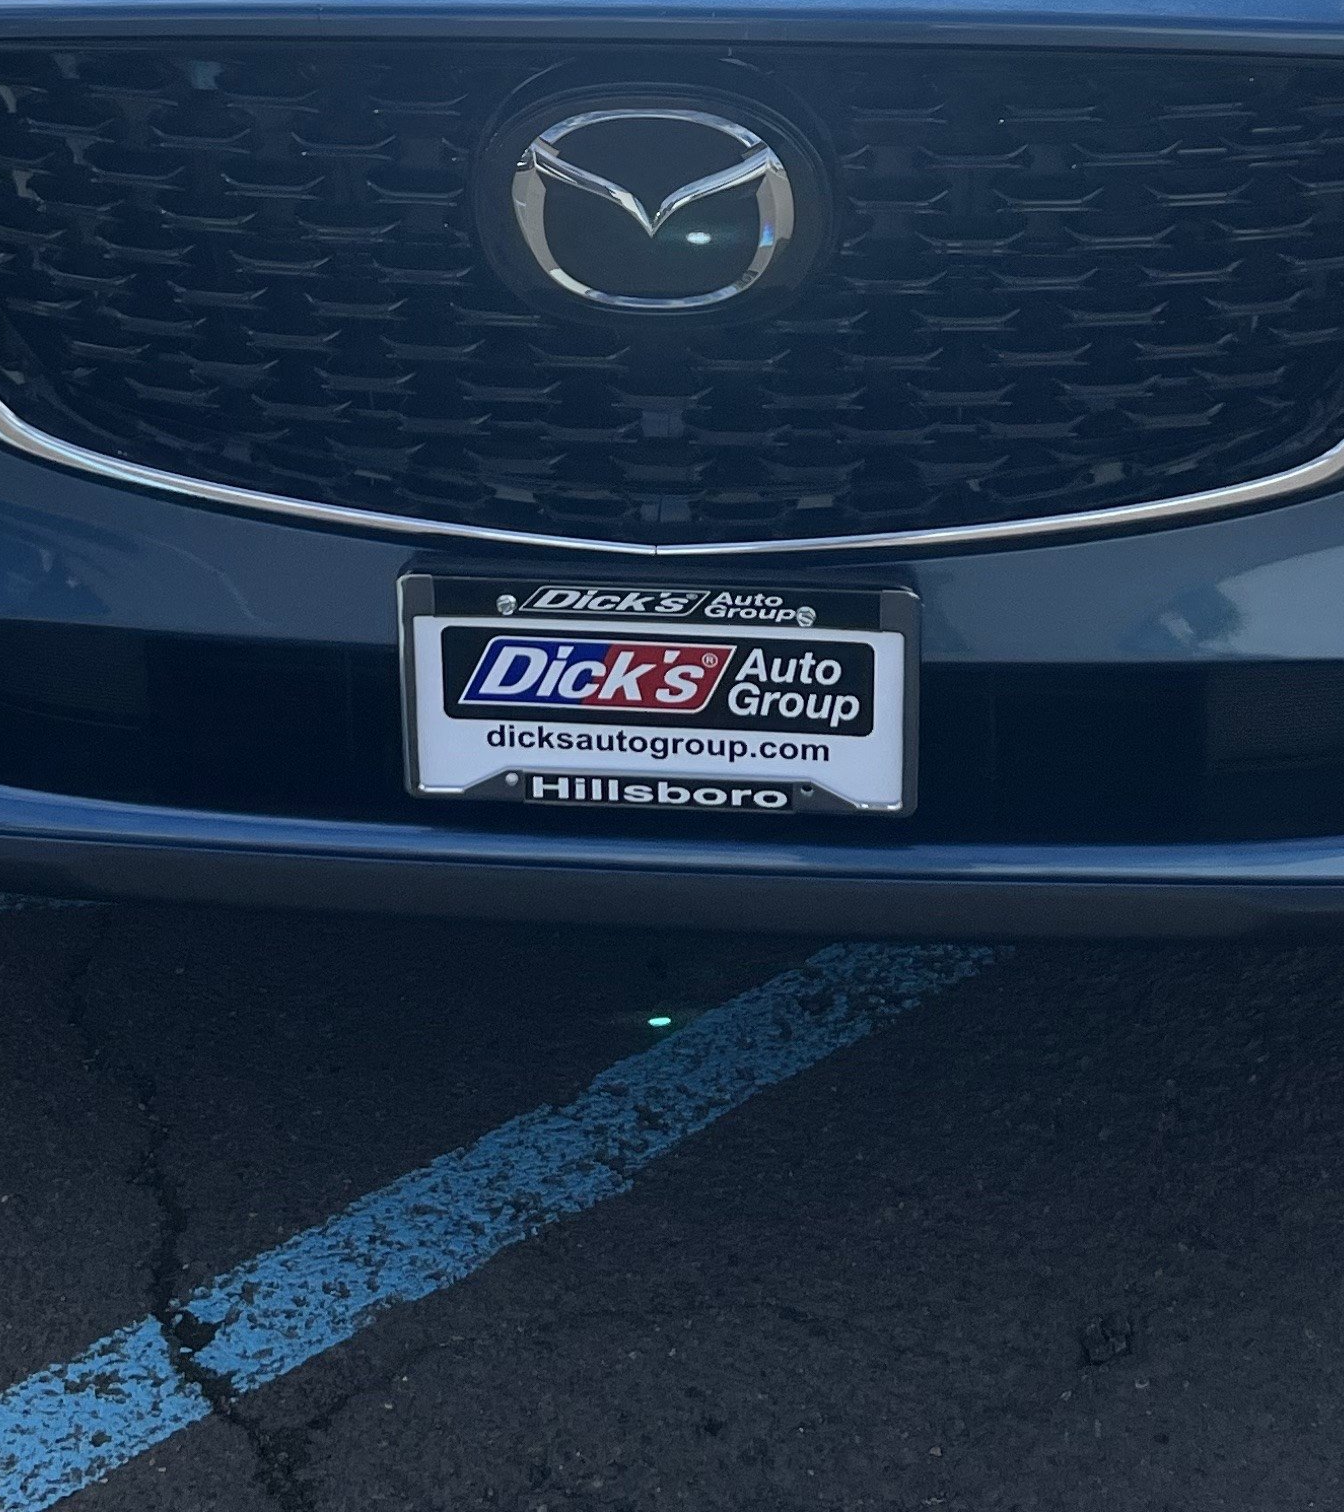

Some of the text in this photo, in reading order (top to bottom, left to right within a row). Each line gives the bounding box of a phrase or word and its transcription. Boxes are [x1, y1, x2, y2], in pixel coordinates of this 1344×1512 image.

[704, 604, 798, 623] Group
[711, 591, 784, 607] Auto
[735, 648, 842, 686] Auto
[727, 682, 860, 727] Group
[486, 724, 830, 763] dicksautogroup.com
[531, 775, 789, 810] Hillsboro
